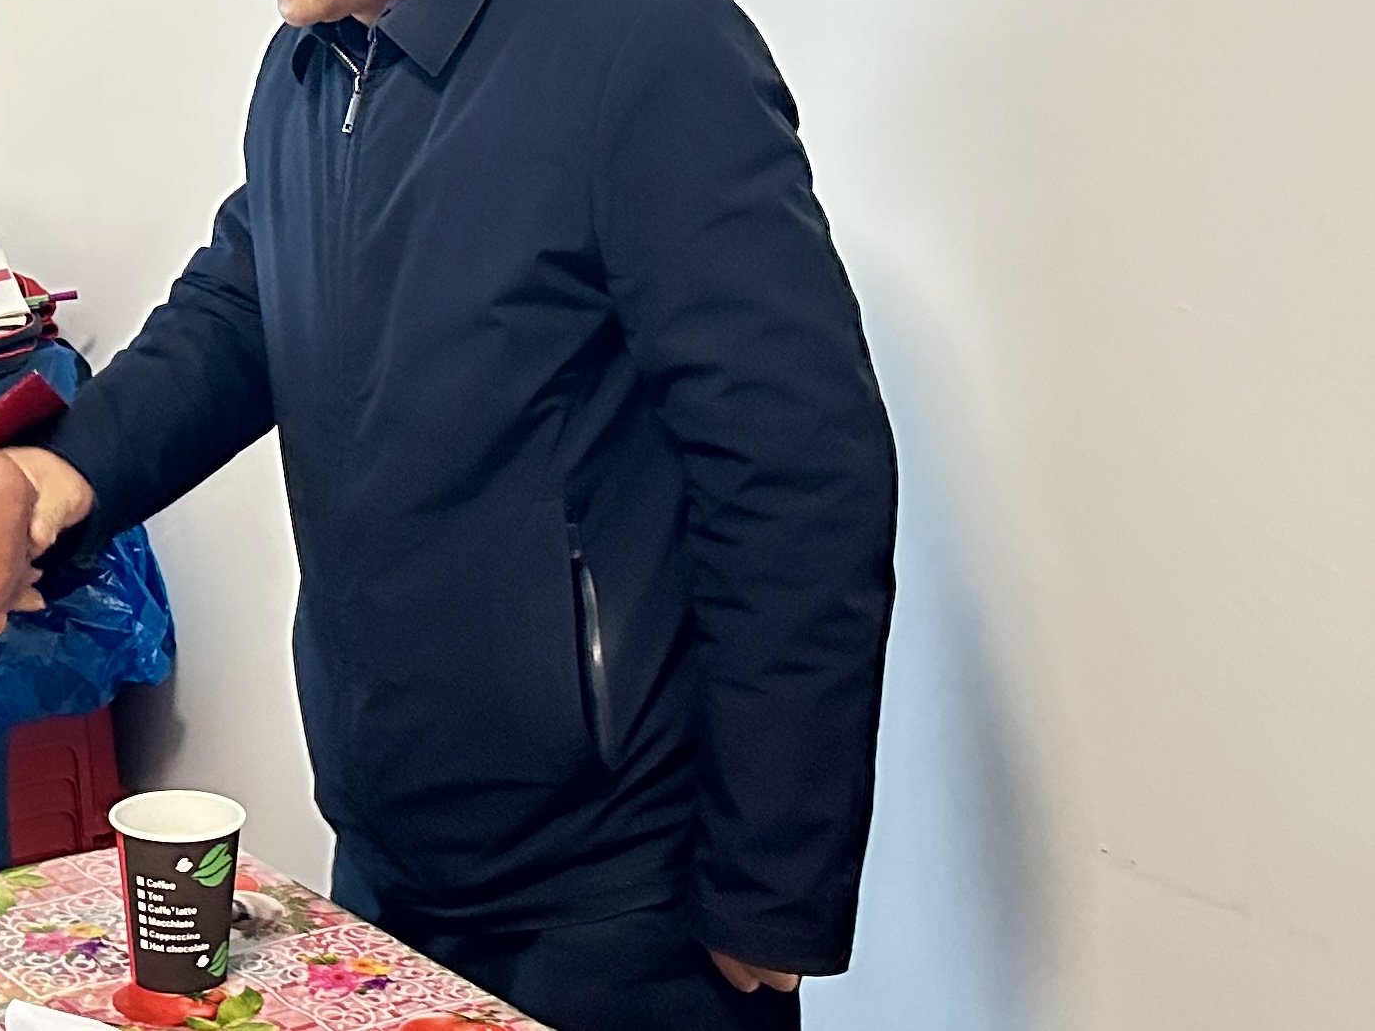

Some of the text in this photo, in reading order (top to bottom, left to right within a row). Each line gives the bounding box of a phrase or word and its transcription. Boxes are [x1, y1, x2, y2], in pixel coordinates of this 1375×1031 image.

[146, 878, 177, 891] Coffee
[146, 891, 164, 902] Tea
[148, 915, 195, 928] Macchiato
[149, 930, 201, 942] Cappuccino
[149, 941, 210, 953] Hot chocolate
